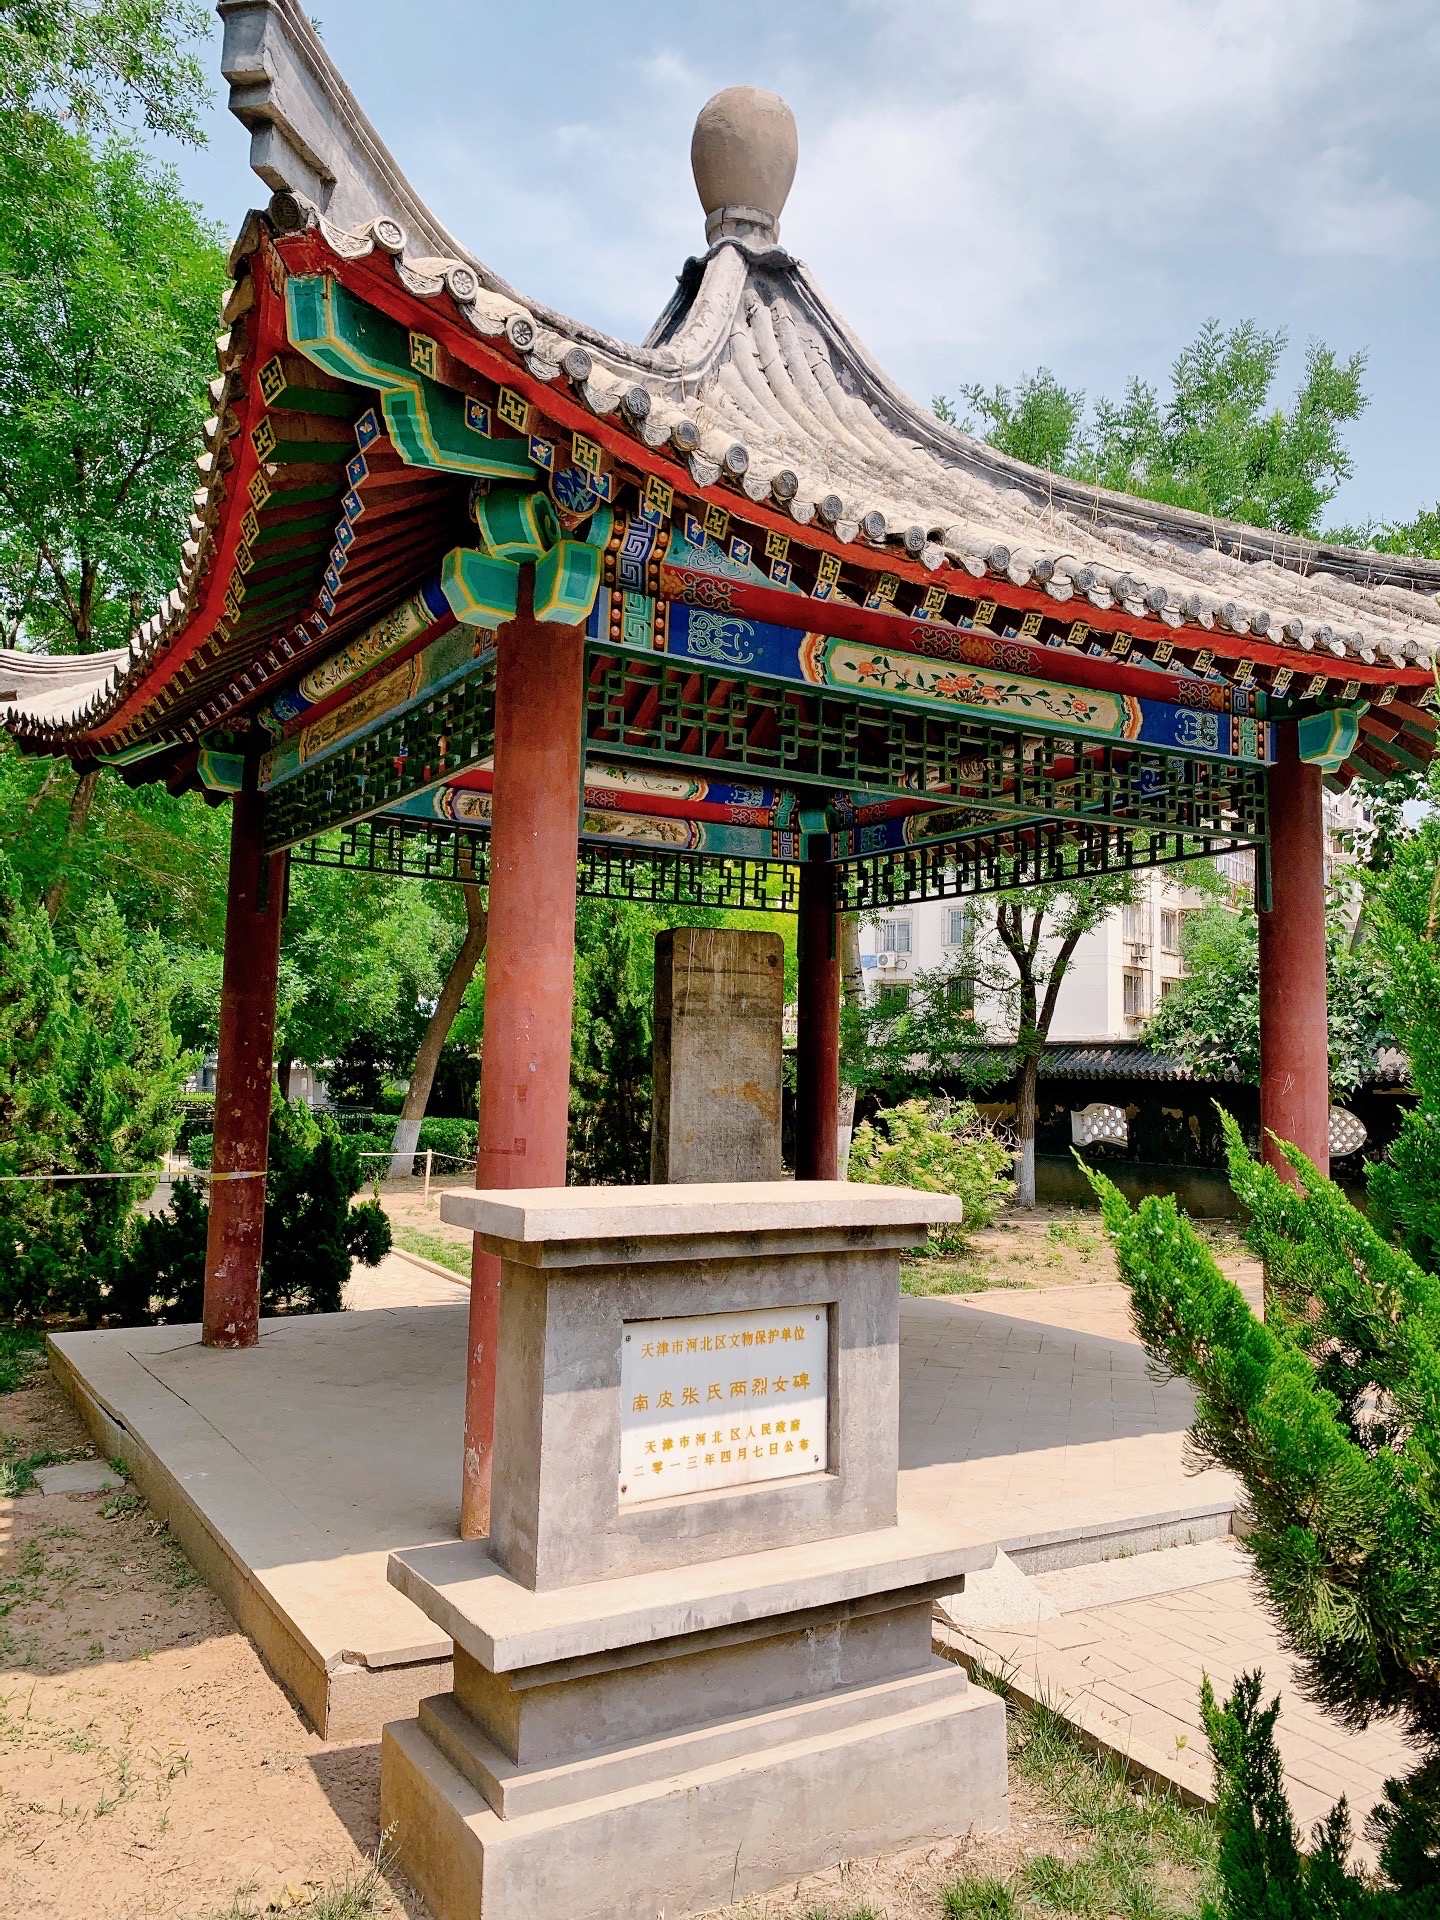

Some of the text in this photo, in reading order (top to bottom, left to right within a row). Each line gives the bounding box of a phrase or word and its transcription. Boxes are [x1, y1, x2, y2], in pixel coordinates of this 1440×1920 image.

[641, 1326, 805, 1358] 天津市河北区文物保护单位
[632, 1372, 810, 1412] 南皮张氏两烈女碑
[644, 1418, 801, 1455] 天津市河北区人民政府
[633, 1438, 809, 1477] 二零一三年四月七日公布
